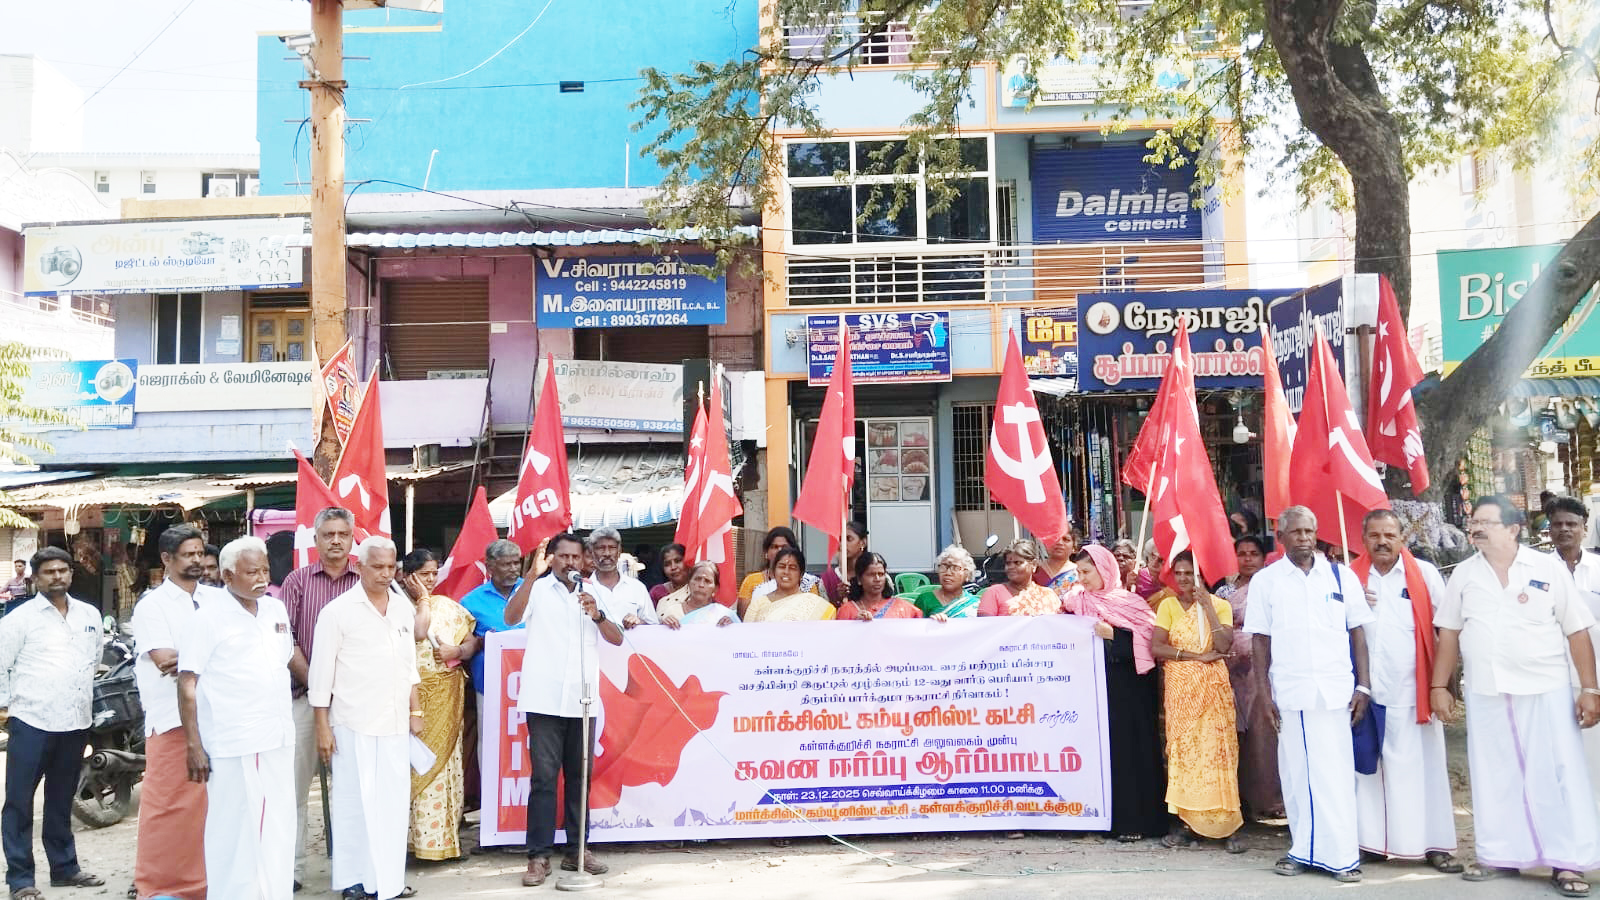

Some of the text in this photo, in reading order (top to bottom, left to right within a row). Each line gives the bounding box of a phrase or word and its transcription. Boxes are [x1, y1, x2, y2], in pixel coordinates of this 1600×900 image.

[1056, 189, 1189, 217] Dalmia
[1104, 215, 1188, 232] cement
[575, 281, 599, 292] Cell
[610, 279, 687, 291] 9442245819
[575, 316, 599, 327] Cell
[610, 313, 688, 326] 8903670264
[859, 314, 899, 329] SVS
[1123, 297, 1264, 337] நேதாஜி
[139, 371, 206, 388] ஜெராக்ஸ்
[209, 372, 220, 384] &
[754, 664, 829, 676] கள்ளக்குறிச்சி
[831, 663, 882, 675] நகரத்தில்
[884, 662, 938, 674] அடிப்படை
[941, 662, 967, 672] வசதி
[969, 660, 1009, 672] மற்றும்
[739, 673, 1071, 691] வசதியின்றி இருட்டில் மூழ்கிவரும் 12-வது வார்டு பெரியார் நகரை
[848, 693, 902, 703] பார்க்குமா
[905, 692, 950, 702] நகராட்சி
[952, 689, 1003, 700] நிர்வாகம்
[733, 709, 851, 733] மார்க்சிஸ்ட்
[856, 704, 981, 735] கம்யூனிஸ்ட்
[985, 703, 1036, 726] கட்சி
[800, 735, 1017, 752] கள்ளக்குறிச்சி நகராட்சி அலுவலகம் முன்பு
[734, 746, 1082, 782] கவன ஈர்ப்பு ஆர்ப்பாட்டம்
[800, 790, 860, 800] 23.12.2025
[862, 785, 945, 799] செவ்வாய்க்கிழமை
[947, 786, 979, 795] காலை
[981, 785, 1005, 794] 11.00
[805, 806, 877, 821] கம்யூனிஸ்ட்
[880, 804, 909, 816] கட்சி
[919, 799, 1014, 815] கள்ளக்குறிச்சி
[1016, 801, 1084, 816] வட்டக்குழு
